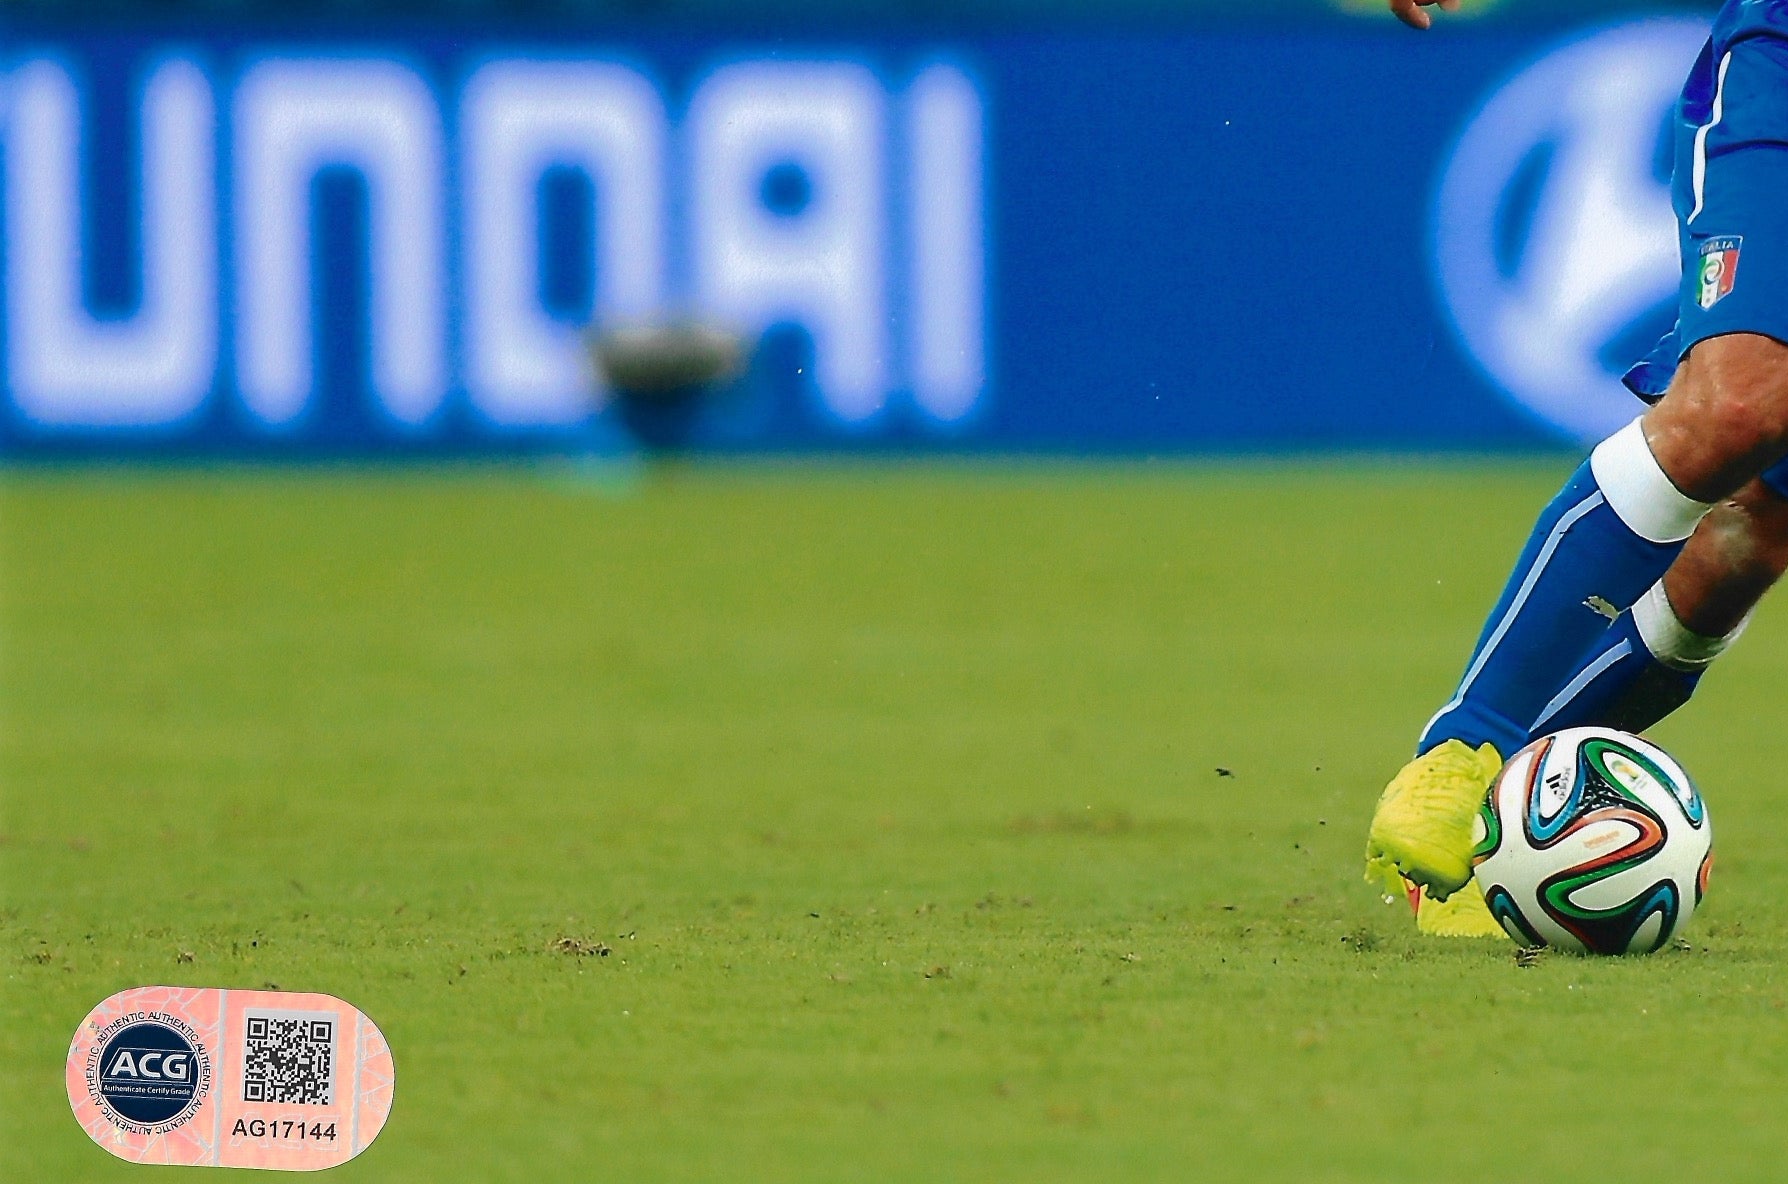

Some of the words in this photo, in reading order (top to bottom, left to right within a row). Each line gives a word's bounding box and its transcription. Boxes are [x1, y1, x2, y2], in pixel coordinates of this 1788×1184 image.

[97, 1011, 145, 1045] AUTHENTIC
[148, 1011, 199, 1042] AUTHENTIC
[86, 1046, 103, 1106] AUTHENTIC
[111, 1051, 188, 1079] ACG
[103, 1084, 146, 1093] Authenticate
[147, 1087, 170, 1095] Certify
[170, 1087, 191, 1095] Grade
[231, 1118, 337, 1141] AG17144
